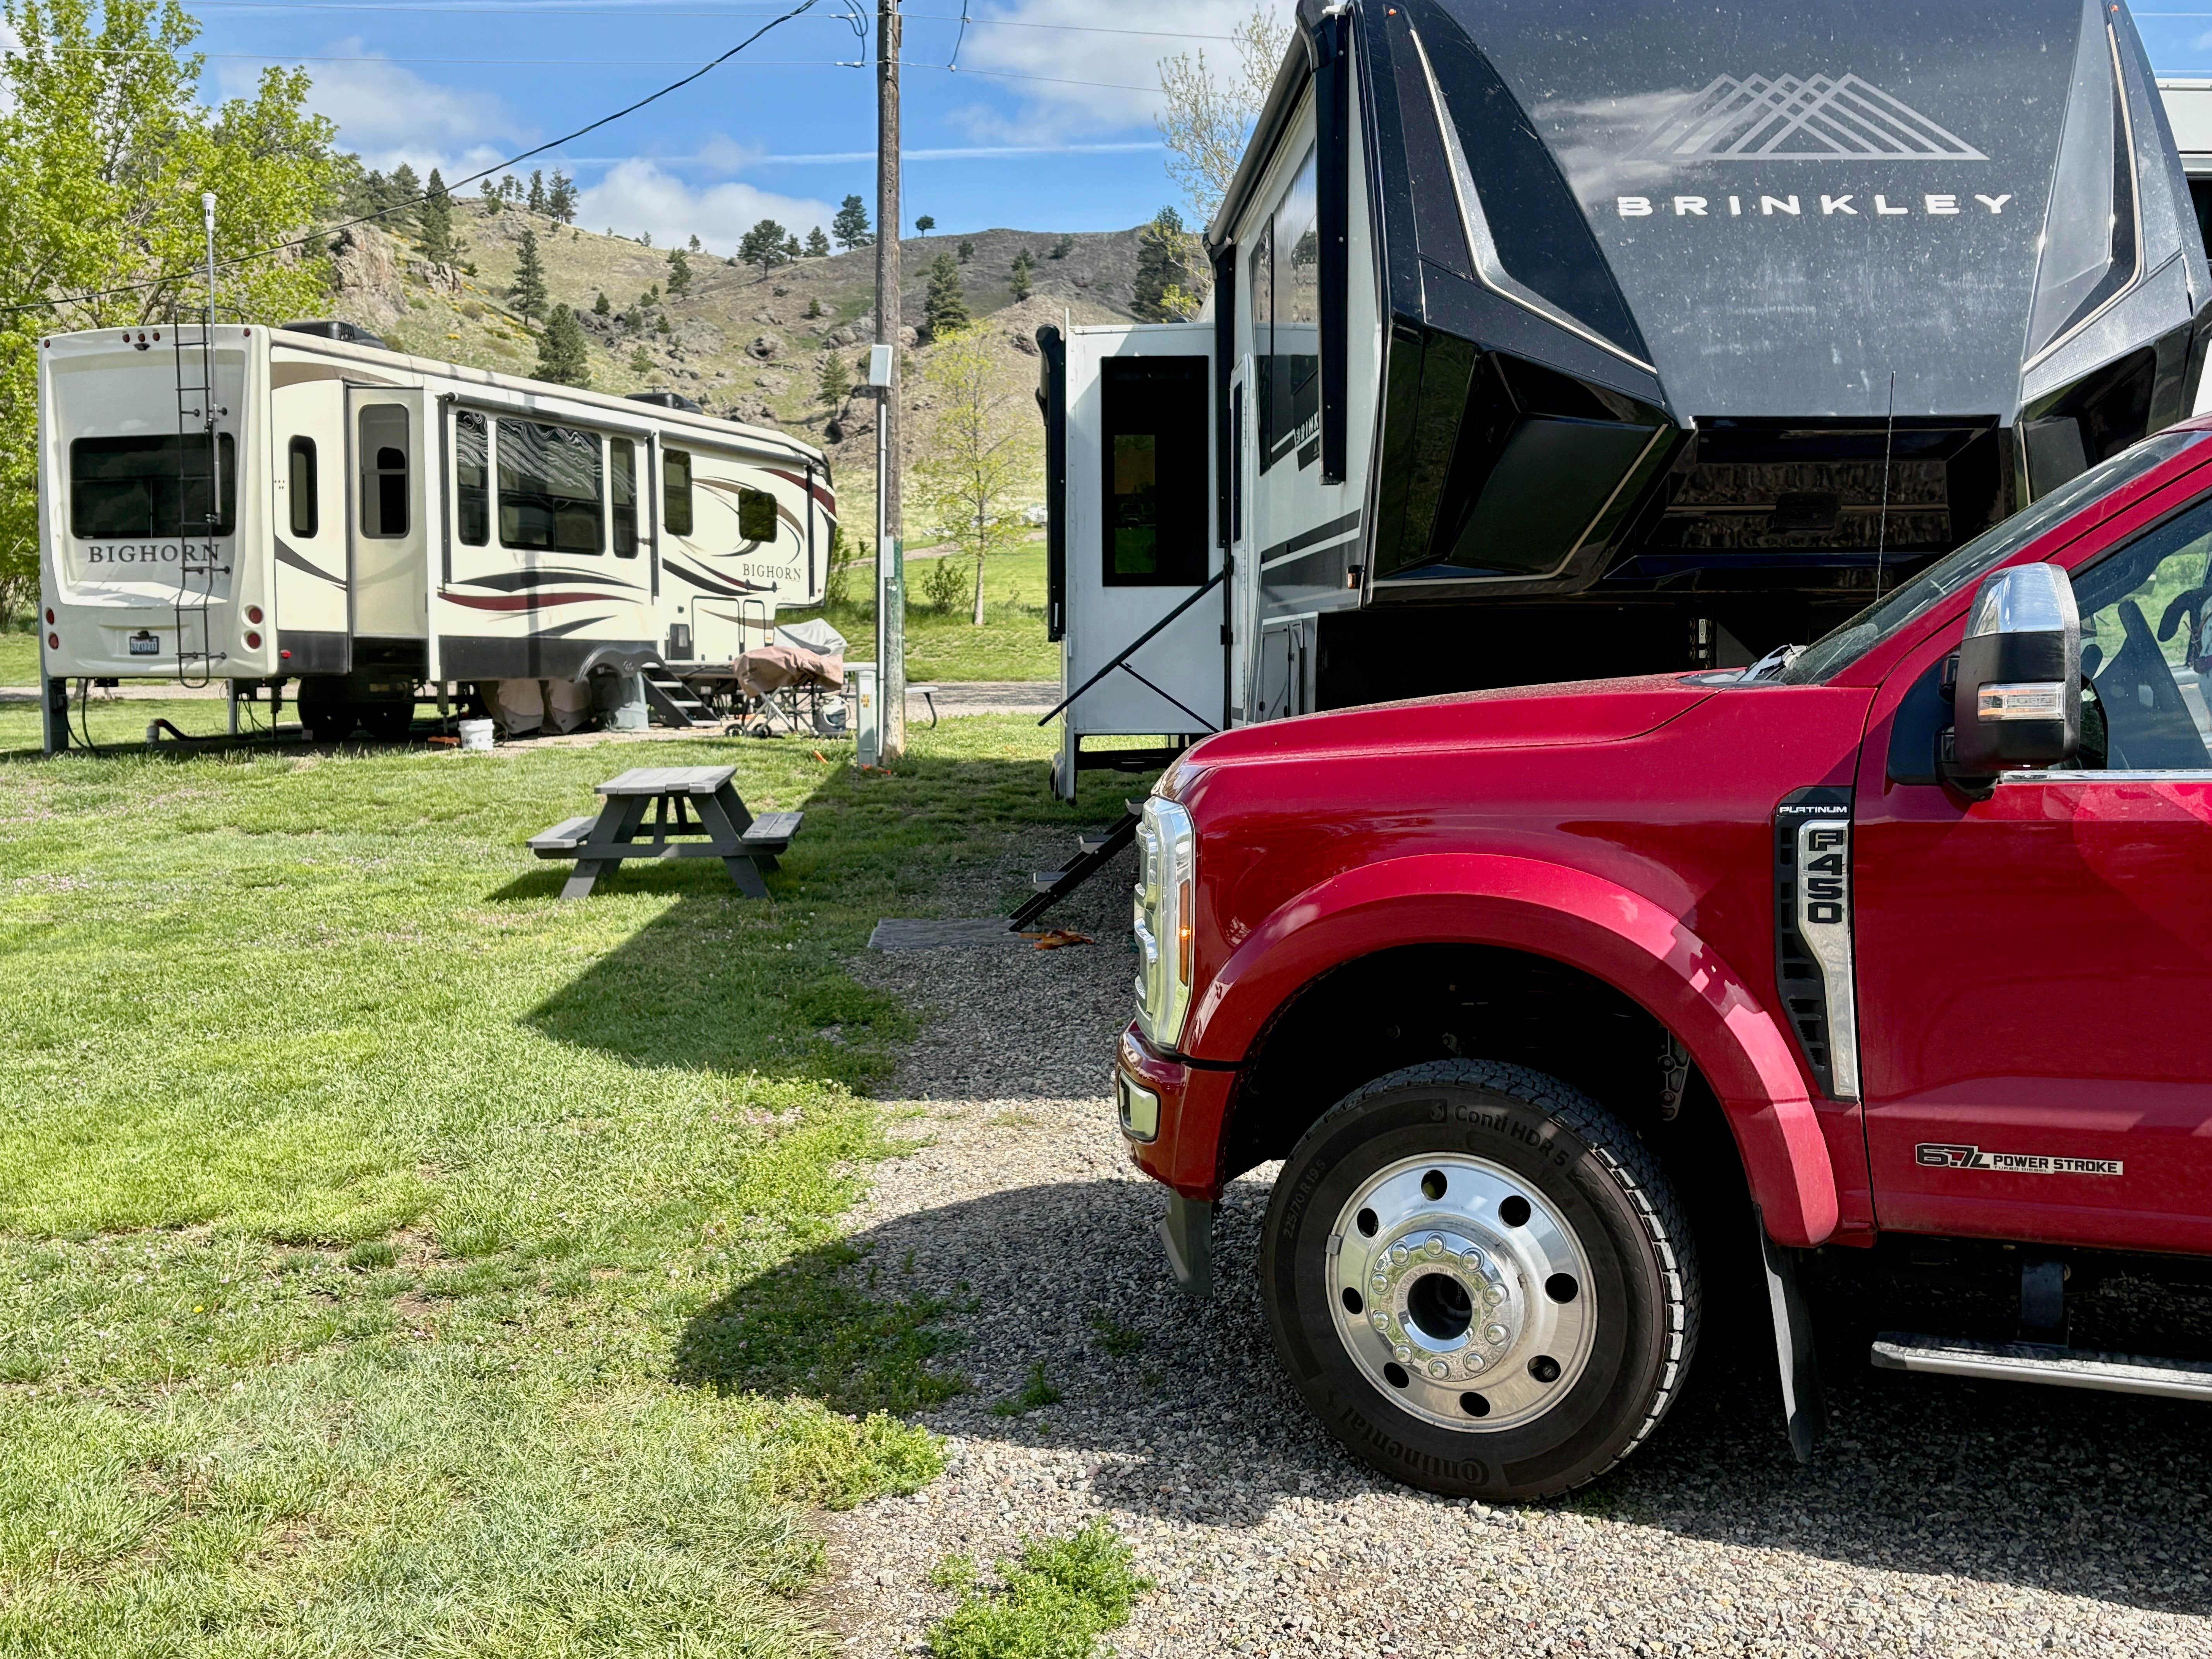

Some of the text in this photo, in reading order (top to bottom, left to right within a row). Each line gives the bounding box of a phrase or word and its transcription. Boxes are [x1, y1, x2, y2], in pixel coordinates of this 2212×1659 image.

[1618, 194, 2011, 216] BRINKLEY
[1296, 411, 1318, 445] BRINK
[88, 544, 220, 562] BIGHORN
[743, 563, 801, 580] BIGHORN
[1454, 1105, 1508, 1133] Conti
[1511, 1121, 1554, 1157] HDR
[1917, 1144, 2118, 1173] 6.7L POWER STROKE
[1338, 1407, 1490, 1486] Continental
